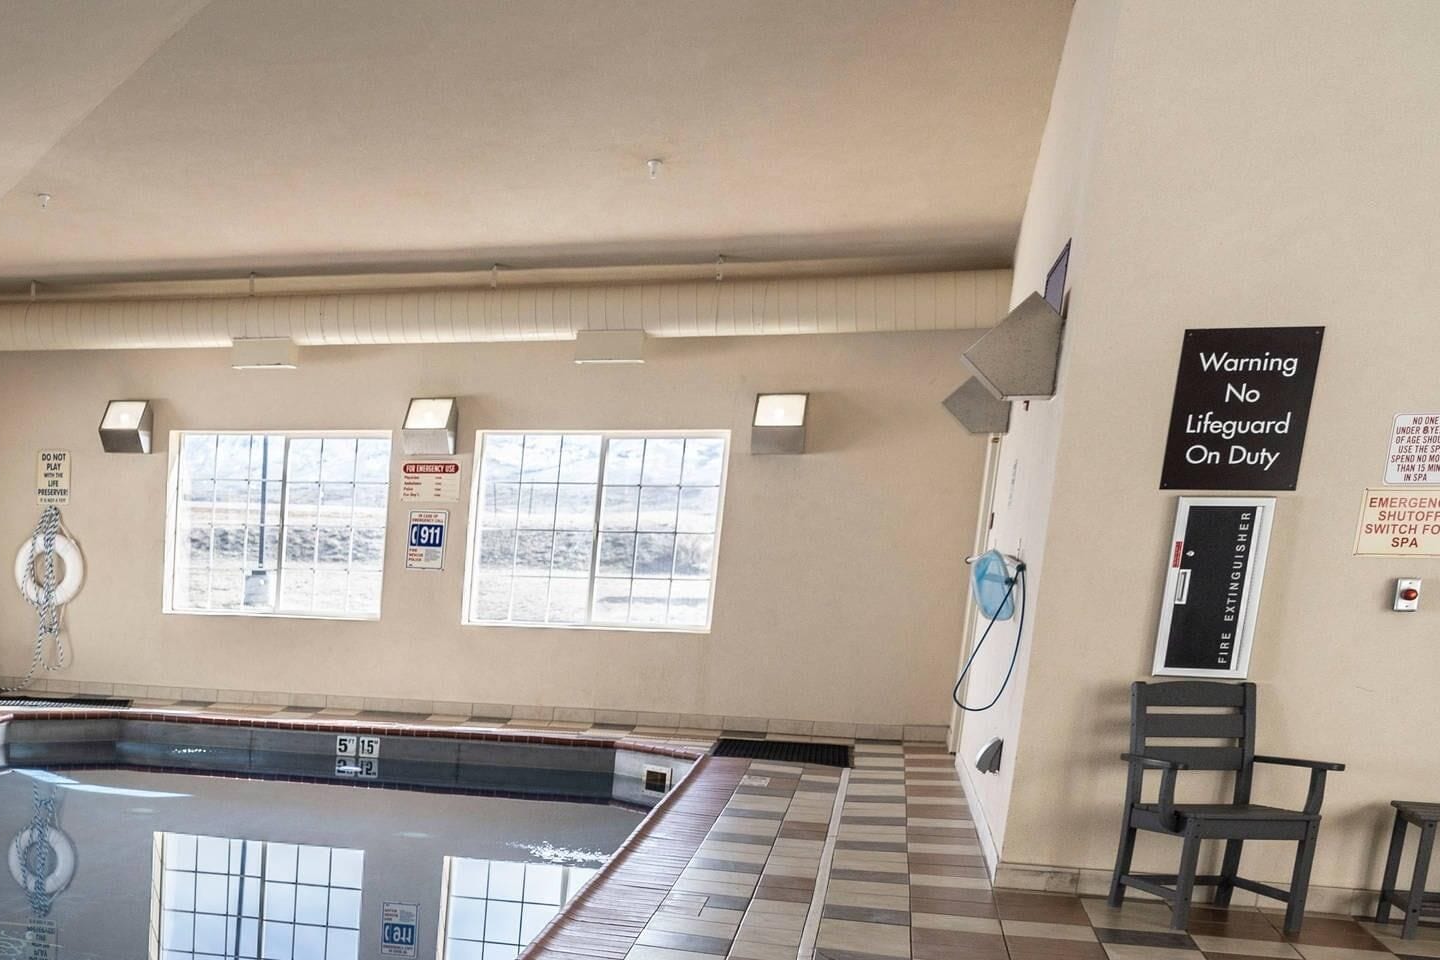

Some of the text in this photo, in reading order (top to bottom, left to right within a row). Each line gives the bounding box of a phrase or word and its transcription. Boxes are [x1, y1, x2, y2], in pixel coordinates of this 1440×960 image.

[1200, 352, 1298, 377] Warning
[1225, 383, 1260, 402] No
[1186, 411, 1291, 439] Lifeguard
[1413, 416, 1440, 425] NO ONE
[1396, 426, 1440, 435] UNDER 8 YE
[1396, 436, 1405, 445] OF
[1407, 436, 1421, 444] AGE
[1399, 445, 1412, 454] USE
[1415, 445, 1429, 454] THE
[42, 453, 66, 461] DO NOT
[1186, 445, 1280, 471] On Duty
[1391, 455, 1415, 464] SPEND
[1417, 455, 1427, 463] NO
[46, 463, 61, 471] PLAY
[406, 464, 456, 473] FOR EMERGENCY USE
[1397, 464, 1416, 472] THAN
[1418, 464, 1426, 472] 15
[1404, 473, 1427, 482] IN SPA
[1369, 497, 1440, 508] EMERGEN
[1378, 510, 1440, 521] SHUTOFF
[1365, 523, 1417, 535] SWITCH
[420, 526, 441, 544] 911
[1391, 537, 1418, 548] SPA
[1218, 512, 1251, 664] FIRE EXTINGUISHER
[338, 738, 348, 753] 5
